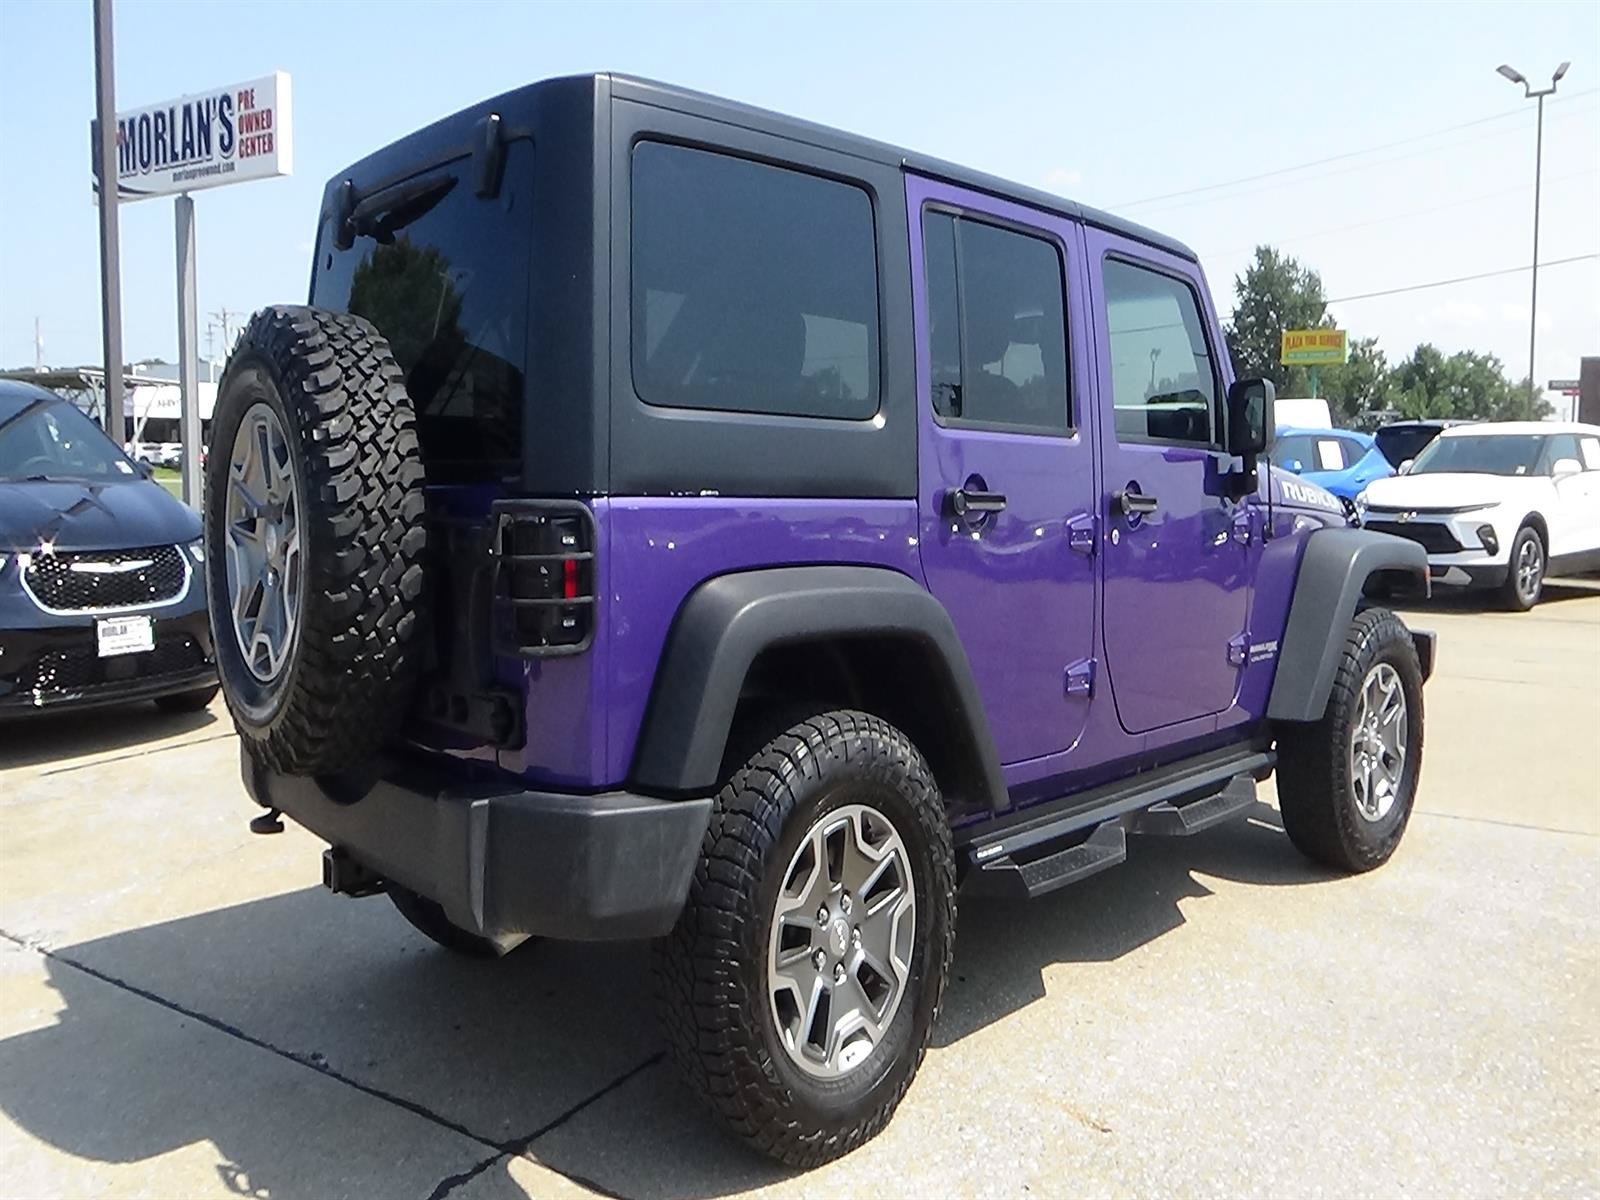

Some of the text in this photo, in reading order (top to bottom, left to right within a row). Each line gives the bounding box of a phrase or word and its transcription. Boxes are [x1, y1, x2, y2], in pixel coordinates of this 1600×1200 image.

[237, 88, 255, 113] PRE
[118, 93, 235, 174] MORLAN'S
[238, 108, 273, 135] OWNED
[239, 132, 274, 159] CENTER
[1285, 335, 1303, 349] PLAZA
[1281, 481, 1340, 510] RUBICO
